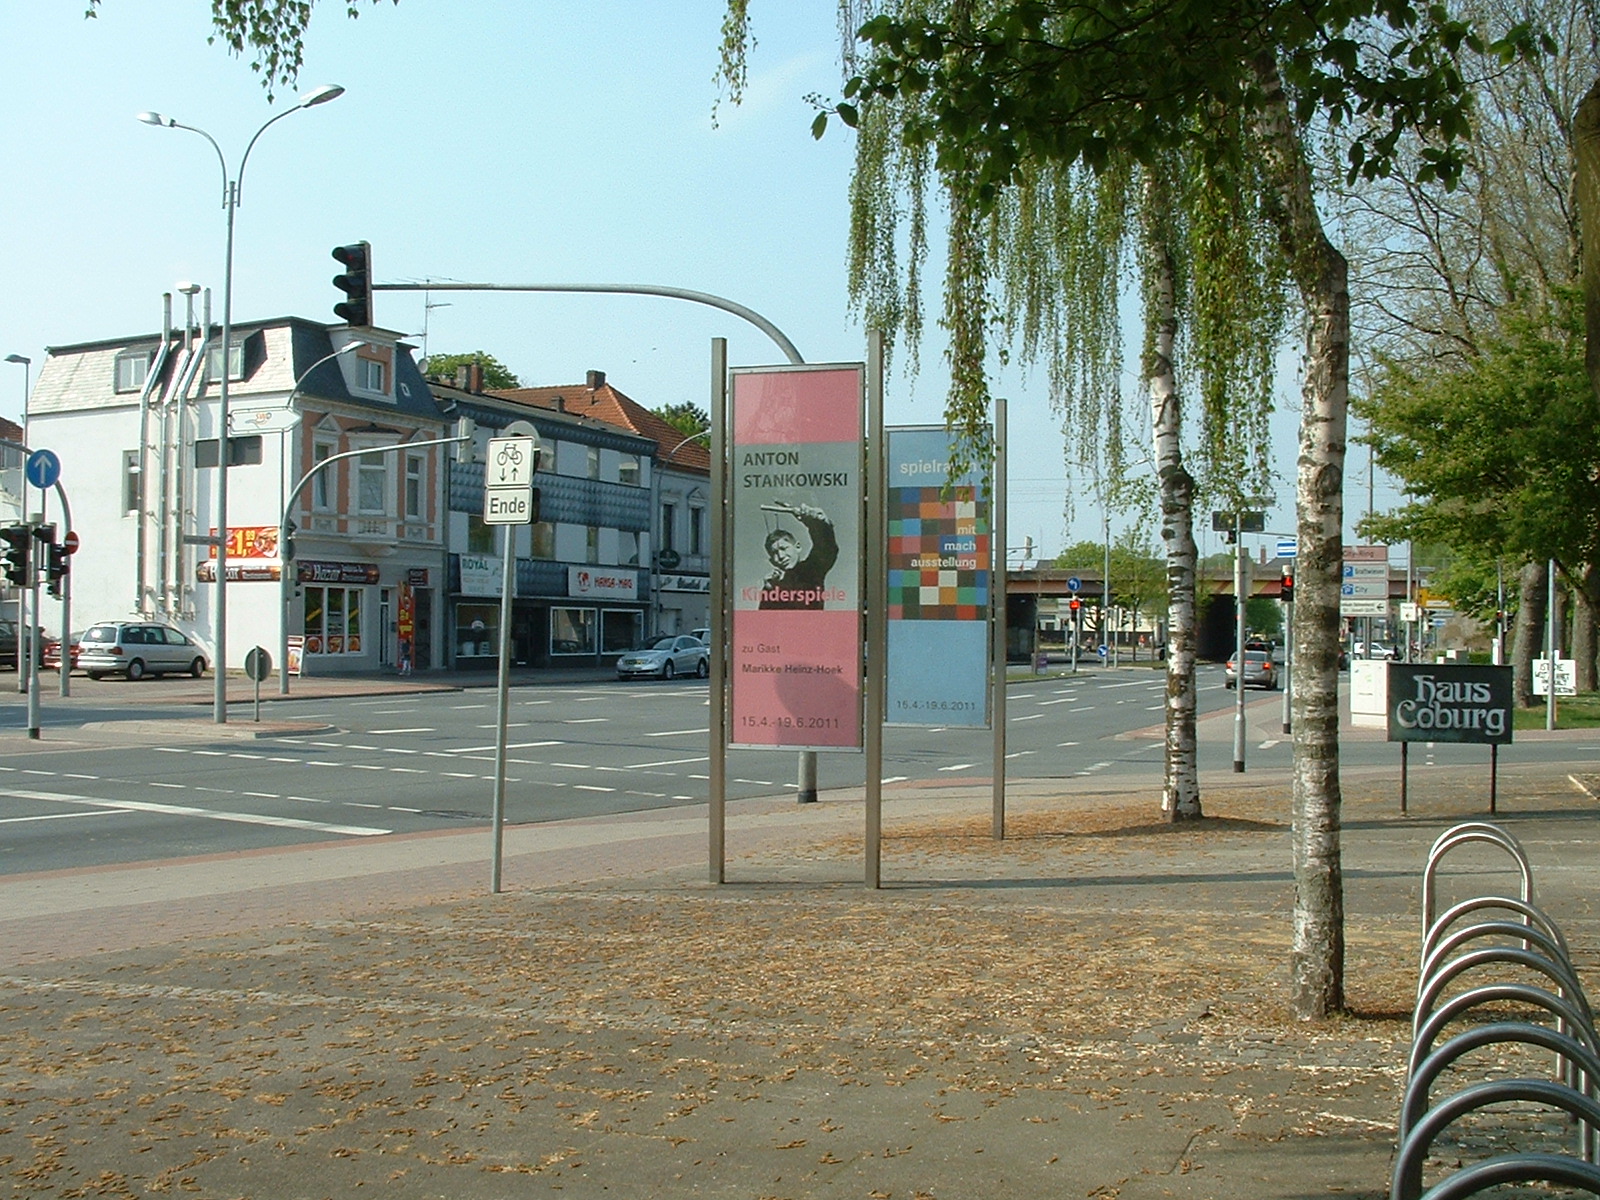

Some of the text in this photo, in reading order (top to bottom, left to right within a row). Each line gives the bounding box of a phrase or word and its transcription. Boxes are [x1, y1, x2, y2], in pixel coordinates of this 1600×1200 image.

[743, 452, 799, 466] ANTON
[900, 460, 977, 476] spielram
[743, 473, 848, 488] STANKOWSKI
[490, 497, 526, 514] Ende
[957, 525, 977, 535] mit
[944, 541, 977, 551] mach
[911, 556, 977, 569] ausstellung
[742, 586, 847, 605] Kinderspiele
[757, 643, 780, 654] Gast
[742, 663, 843, 675] Marikke Heinz-Hoek
[742, 716, 839, 728] 15.4.-19.6.2011
[1396, 699, 1506, 736] Coburg
